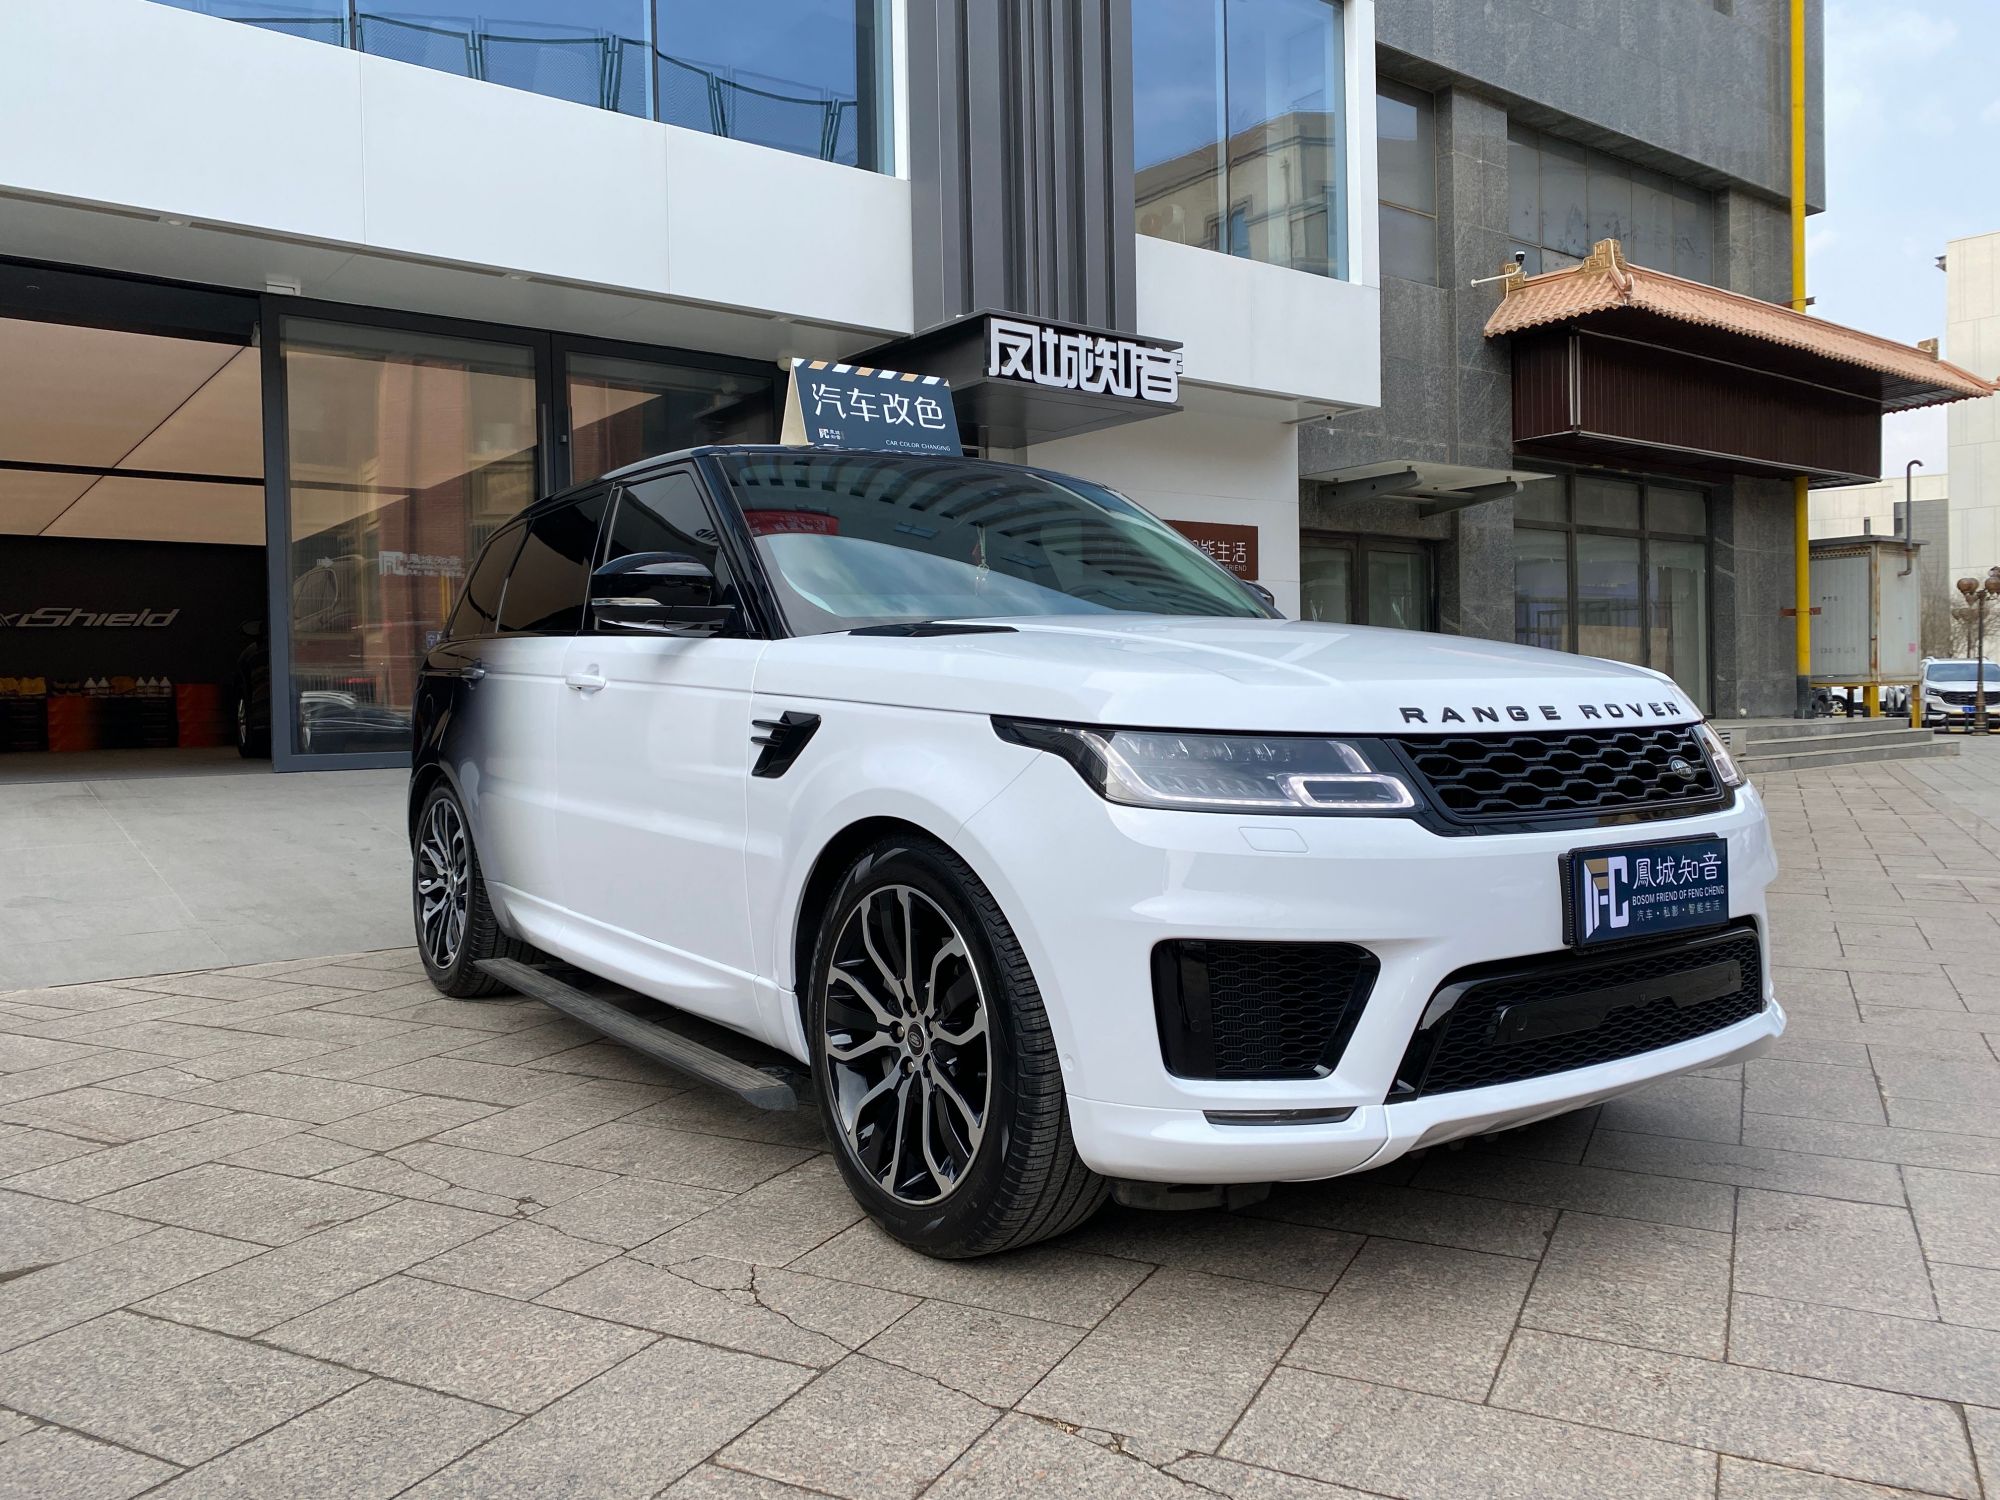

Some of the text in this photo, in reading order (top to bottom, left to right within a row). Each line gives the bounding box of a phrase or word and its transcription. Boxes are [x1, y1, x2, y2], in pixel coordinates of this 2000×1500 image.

[988, 318, 1184, 404] 凤城知音
[811, 383, 946, 430] 汽车改色
[921, 443, 951, 452] CHANGING
[1191, 539, 1247, 563] 能生活
[1399, 701, 1682, 723] RANGE ROVER
[1632, 851, 1722, 889] 鳳城知音
[1632, 885, 1725, 906] BOSOM FRIEND OF FENG CHENG
